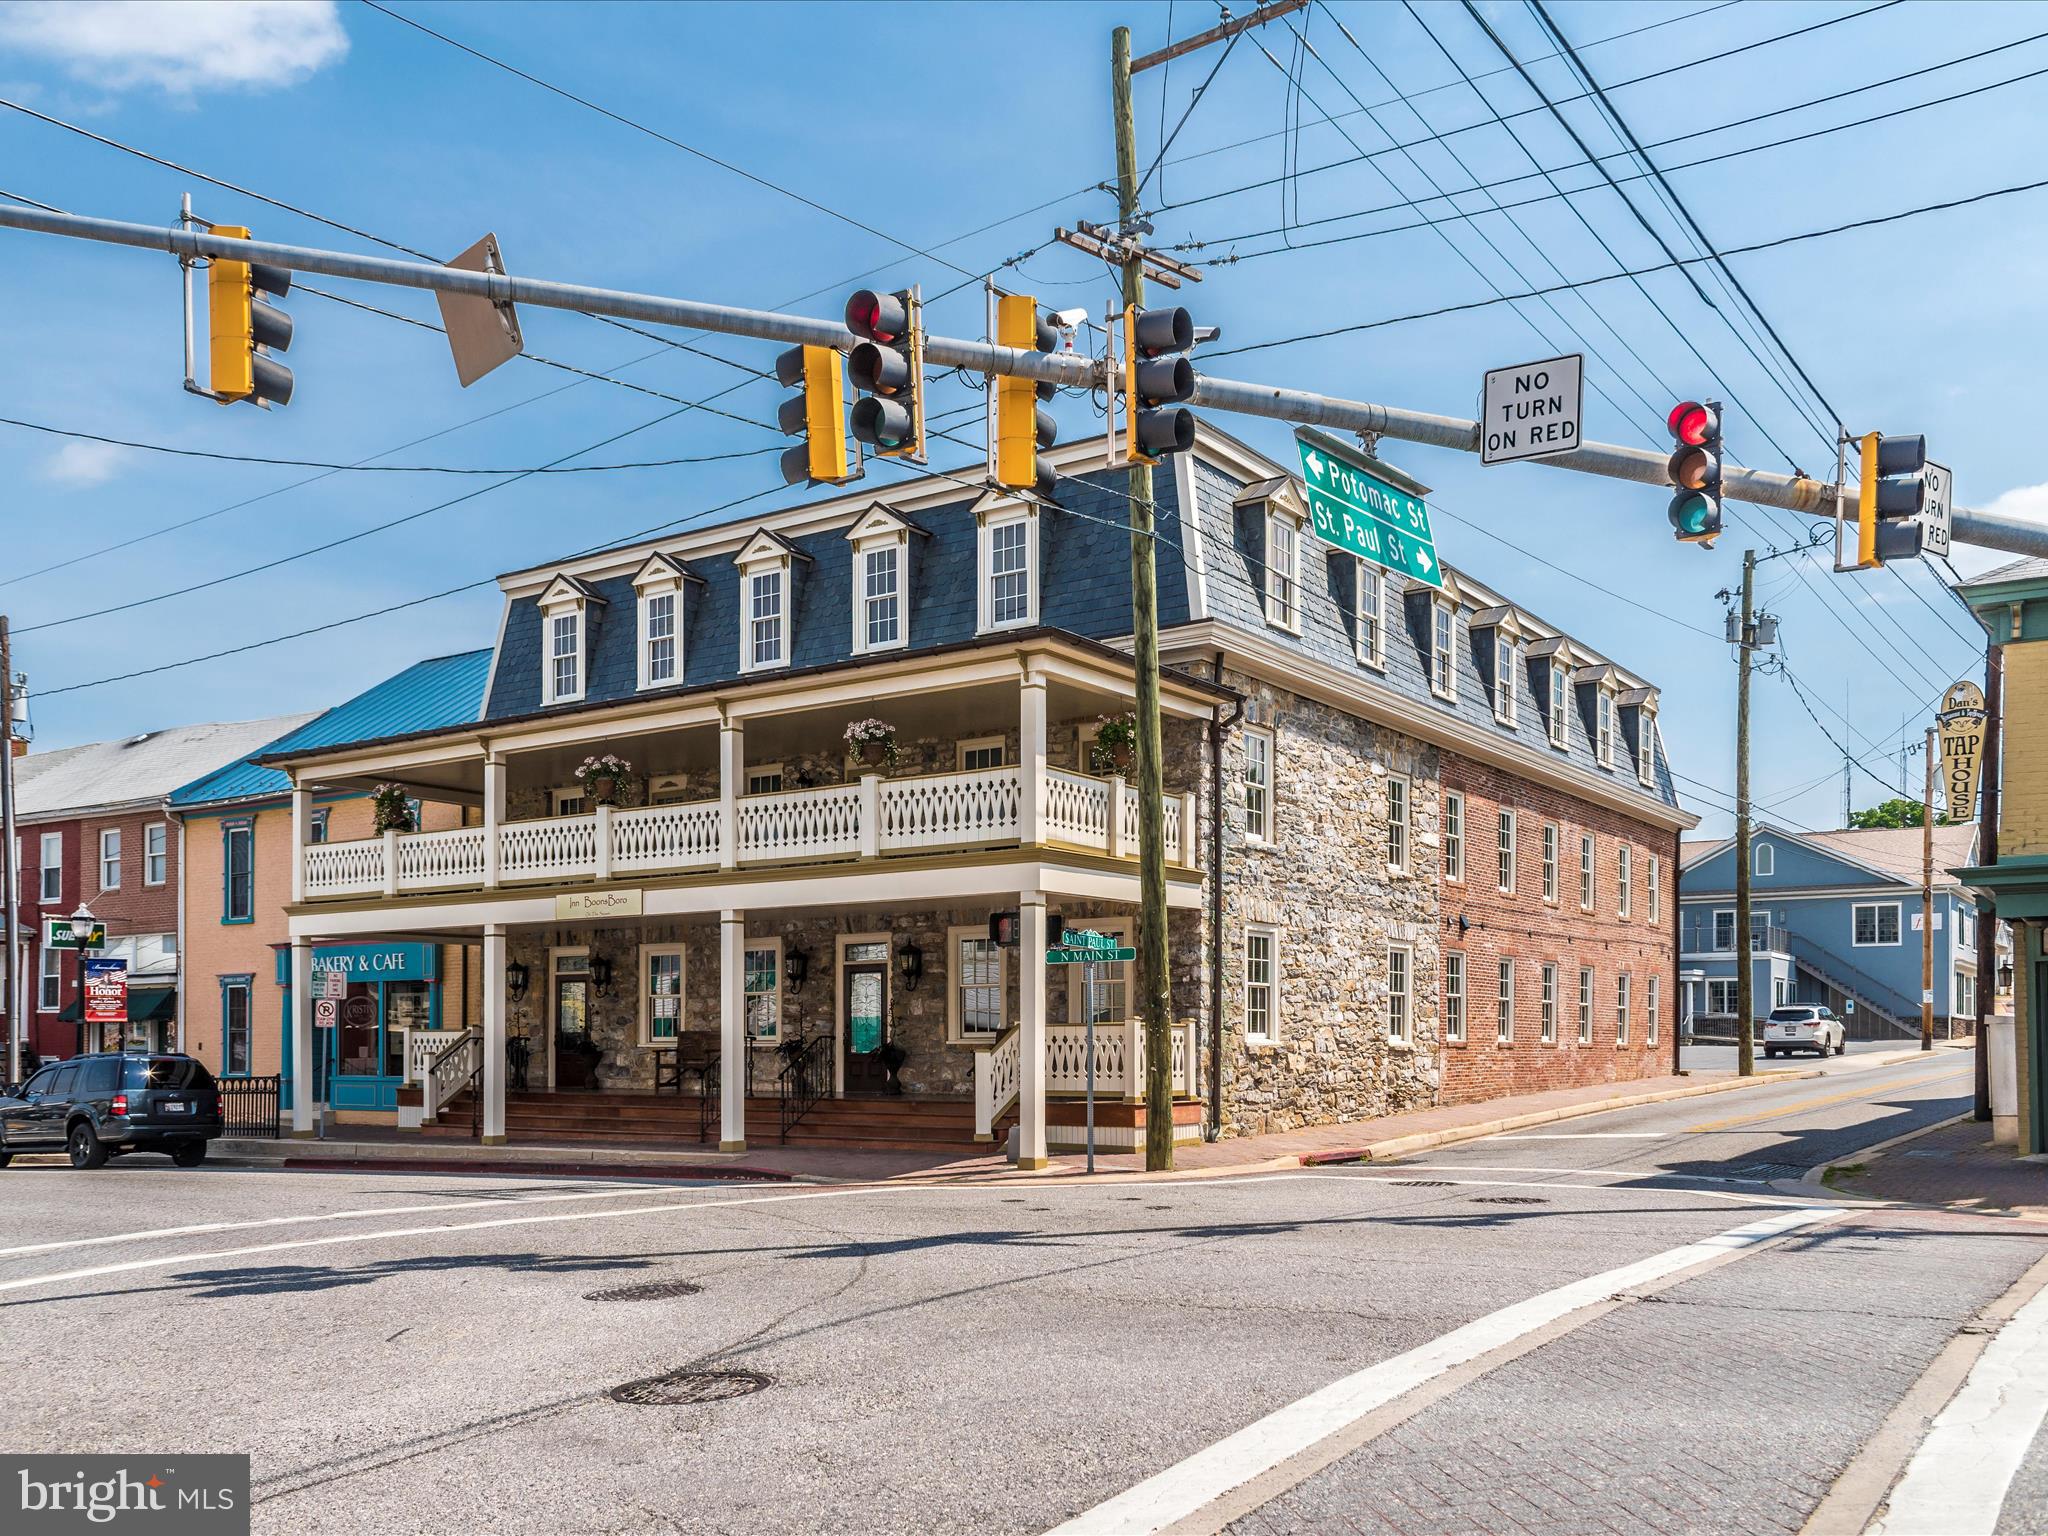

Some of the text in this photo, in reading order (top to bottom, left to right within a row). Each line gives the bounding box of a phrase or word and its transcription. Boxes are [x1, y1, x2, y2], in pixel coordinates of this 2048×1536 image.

[1515, 372, 1549, 394] NO
[1502, 395, 1562, 422] TURN
[1488, 421, 1575, 451] ON RED
[1924, 472, 1939, 492] NO
[1327, 460, 1426, 532] Potomac St
[1924, 497, 1943, 519] URN
[1315, 501, 1407, 565] St. Paul St
[1928, 525, 1947, 546] RED
[1948, 697, 1979, 710] Dan's
[1943, 735, 1979, 756] TAP
[1951, 757, 1973, 818] HOUSE
[569, 893, 628, 909] Inn BoonsBoro
[52, 930, 103, 942] SUBAY
[1065, 932, 1115, 949] SAINT PAUL ST
[312, 953, 405, 972] BAKERY & CAFE
[1061, 949, 1120, 961] N MAIN ST
[90, 986, 123, 996] Honor
